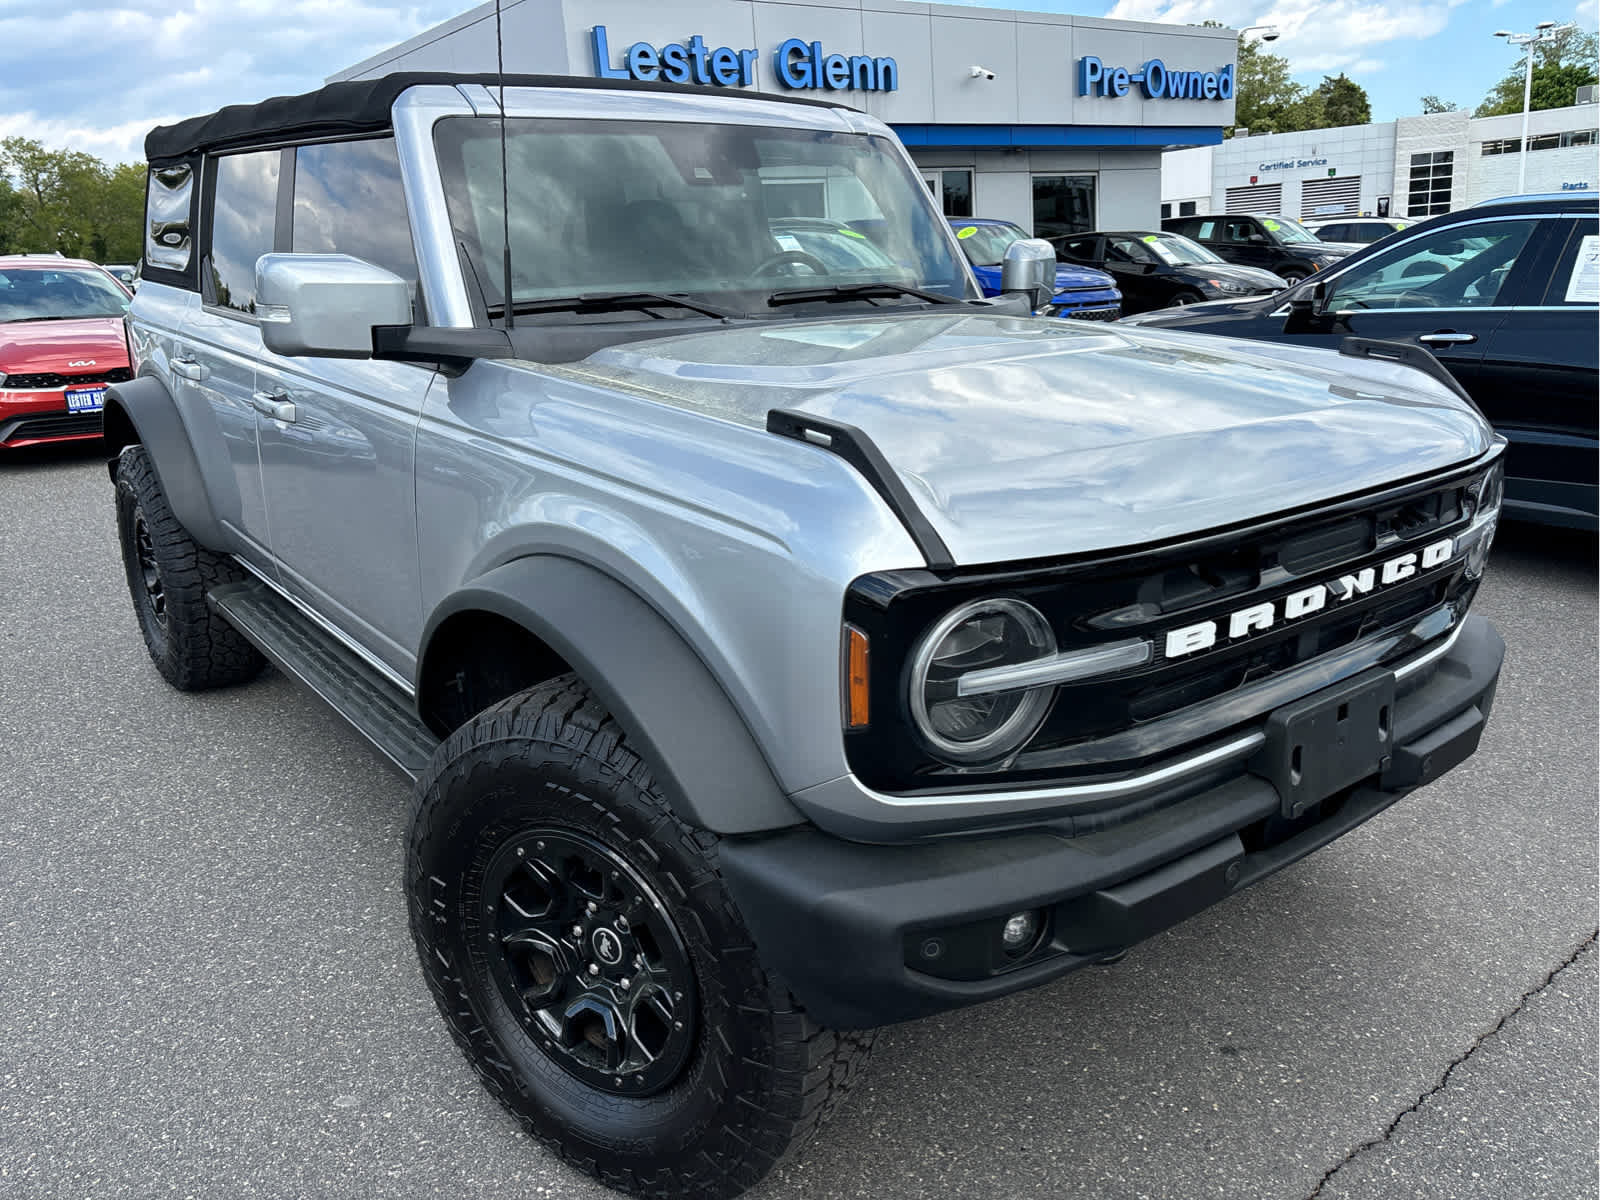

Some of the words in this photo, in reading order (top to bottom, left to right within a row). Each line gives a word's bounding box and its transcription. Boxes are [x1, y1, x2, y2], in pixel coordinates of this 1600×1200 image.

[588, 25, 758, 87] Lester
[774, 38, 898, 91] Glenn
[1079, 56, 1234, 99] Pre-Owned
[1259, 159, 1294, 171] Certified
[1297, 158, 1327, 168] Service
[1561, 182, 1588, 190] Parts
[67, 392, 93, 408] LESTER
[1165, 538, 1453, 658] BRONCO
